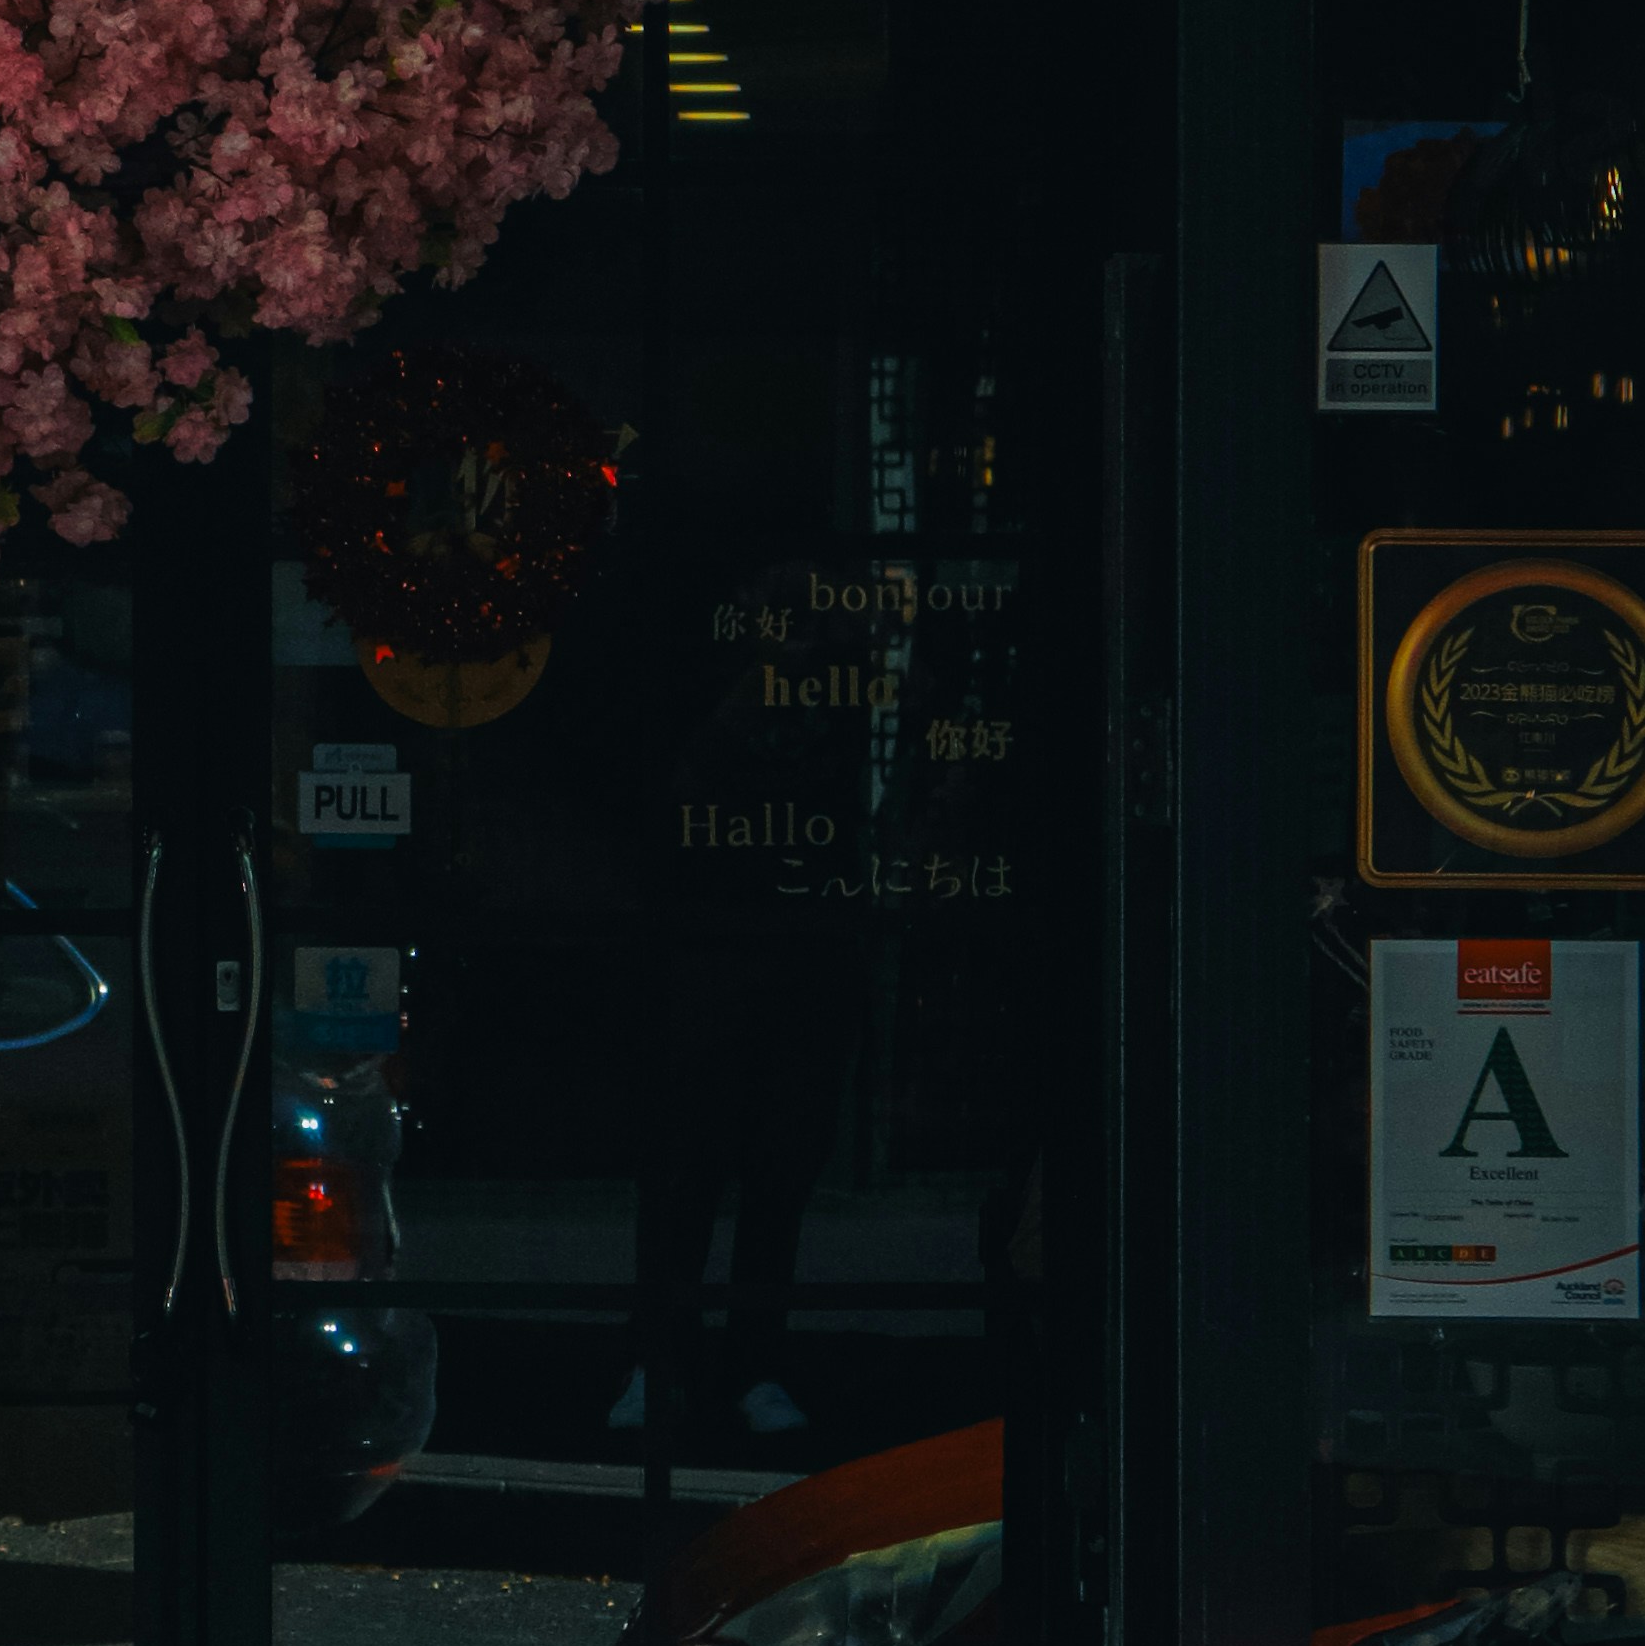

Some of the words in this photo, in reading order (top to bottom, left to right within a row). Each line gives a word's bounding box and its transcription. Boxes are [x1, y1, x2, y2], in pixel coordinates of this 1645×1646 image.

[1330, 382, 1346, 395] in
[1350, 382, 1428, 398] operation
[1353, 363, 1405, 380] CCTV
[807, 572, 1013, 621] bonjour
[711, 603, 794, 644] 你好
[761, 664, 897, 708] hello
[925, 718, 1014, 762] 你好
[314, 785, 400, 822] PULL
[679, 801, 837, 849] Hallo
[776, 853, 1013, 899] こんにちは
[1463, 961, 1543, 985] eatsafe
[1388, 1039, 1435, 1050] SAFETY
[1388, 1050, 1433, 1061] GRADE
[1439, 1026, 1570, 1158] A
[1469, 1166, 1539, 1182] Excellent
[1565, 1291, 1602, 1301] Council
